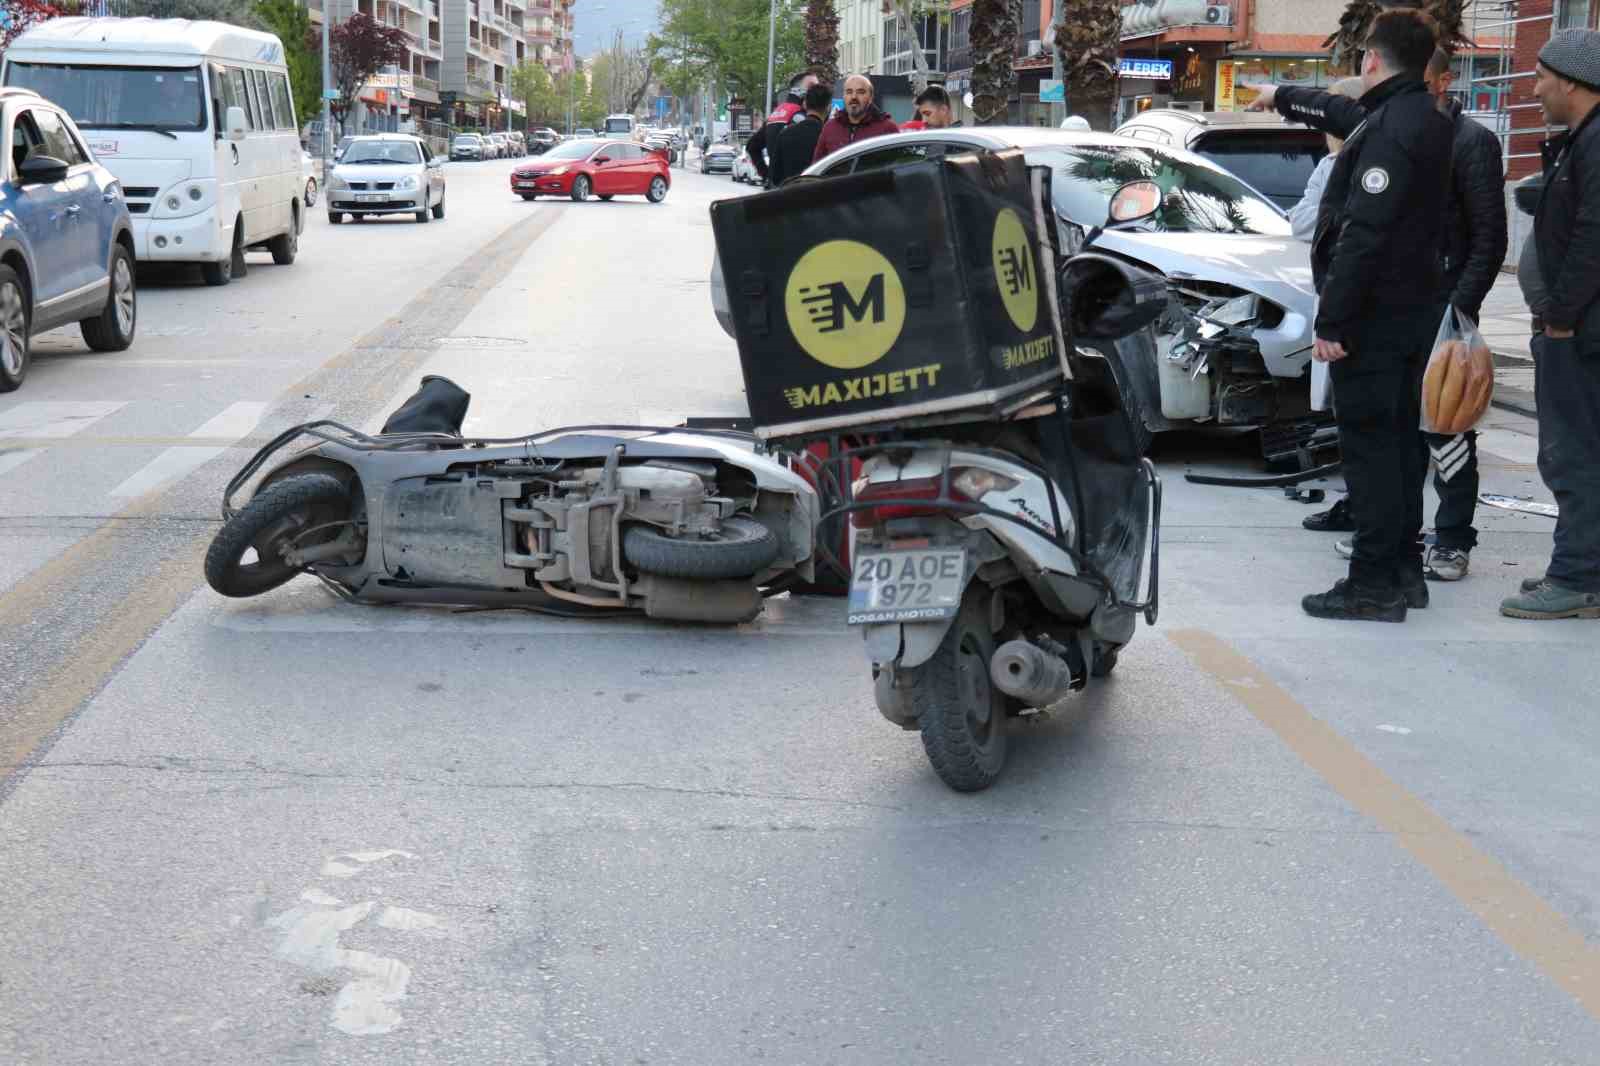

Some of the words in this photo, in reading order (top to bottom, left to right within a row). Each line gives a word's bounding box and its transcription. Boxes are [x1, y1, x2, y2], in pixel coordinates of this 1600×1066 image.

[1004, 244, 1032, 296] M
[817, 273, 885, 332] M
[1004, 336, 1054, 370] MAXIJETT
[784, 363, 941, 409] MAXIJETT
[858, 558, 892, 582] 20
[899, 554, 961, 580] AOE
[881, 582, 932, 607] 972
[896, 607, 945, 620] MOTOR
